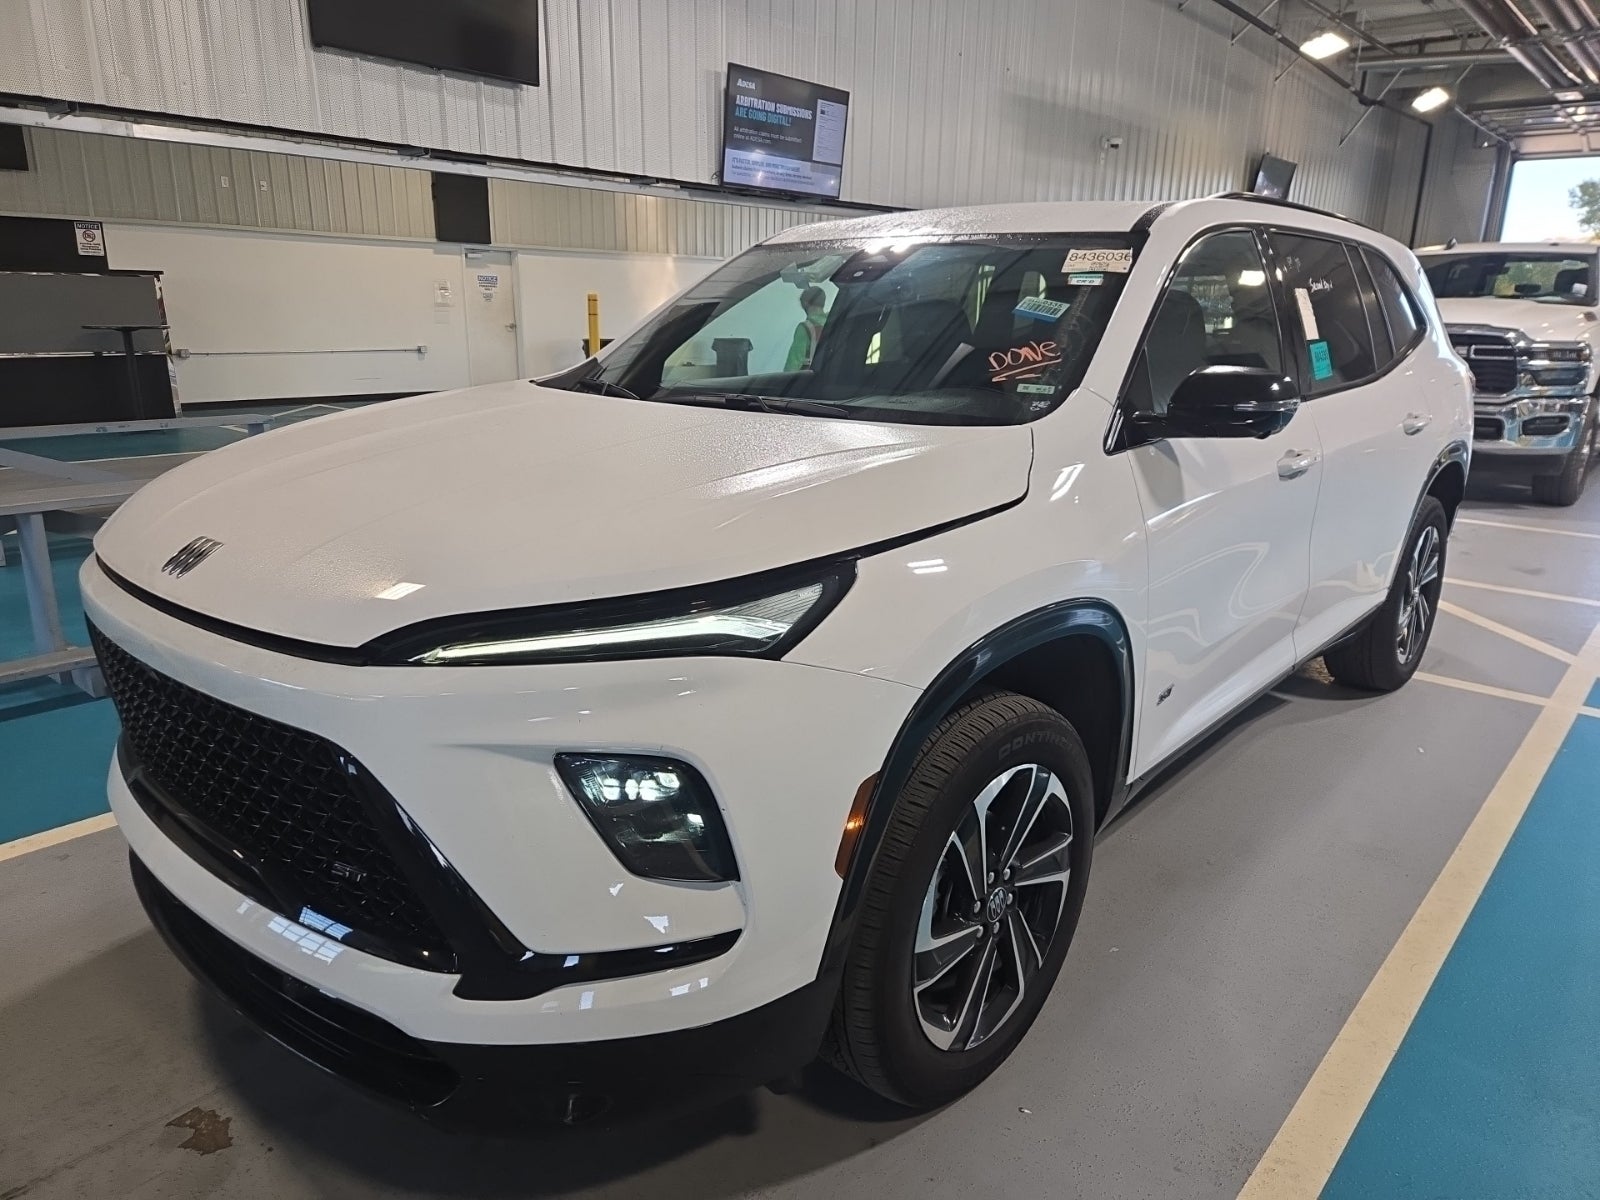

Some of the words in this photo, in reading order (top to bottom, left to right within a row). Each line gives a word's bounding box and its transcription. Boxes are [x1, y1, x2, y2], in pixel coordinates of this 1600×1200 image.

[735, 106, 748, 118] ARE
[748, 108, 767, 122] GOING
[736, 94, 776, 112] ARBITRATION
[776, 103, 813, 120] SUBMISSIONS
